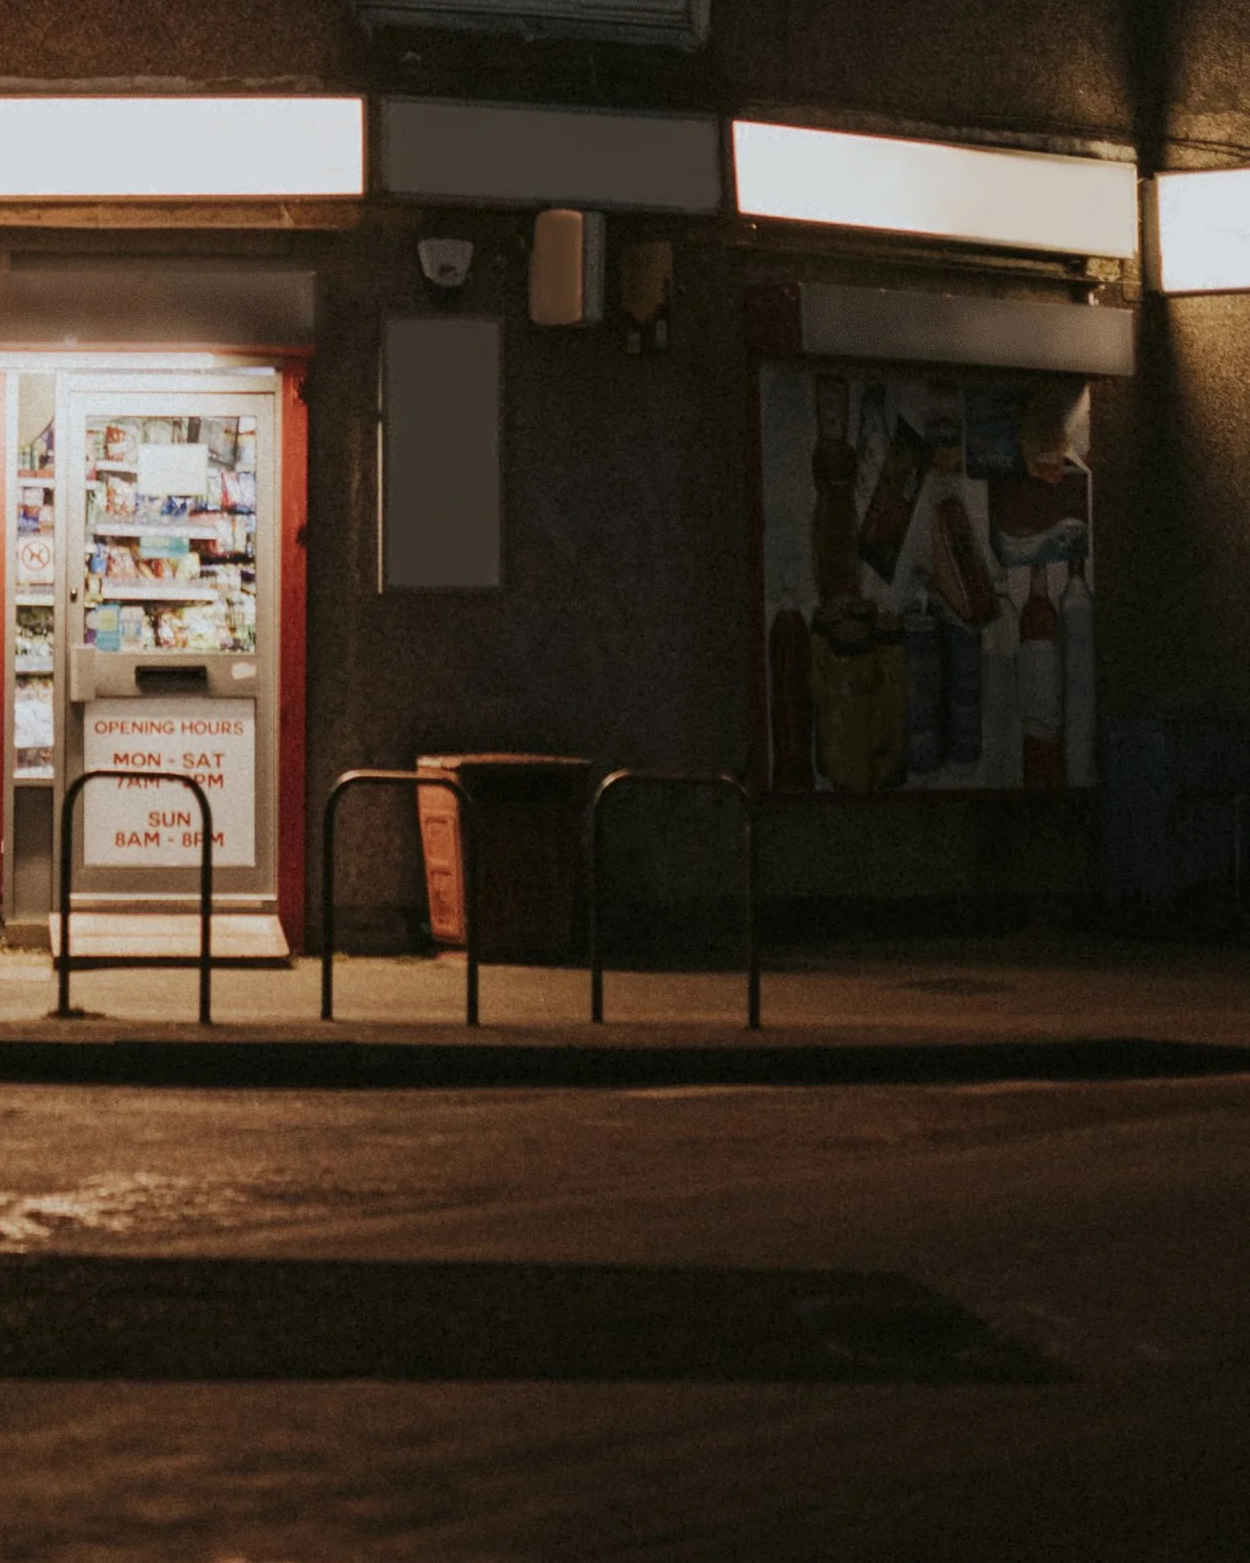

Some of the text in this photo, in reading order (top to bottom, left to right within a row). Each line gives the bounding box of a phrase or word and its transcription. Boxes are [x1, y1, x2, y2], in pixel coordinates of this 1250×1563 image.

[94, 721, 244, 736] OPENING HOURS
[113, 752, 161, 768] MON
[182, 752, 225, 769] SAT
[182, 774, 225, 789] PM
[148, 811, 192, 828] SUN
[114, 831, 160, 848] 8AM
[182, 831, 225, 848] 8PM
